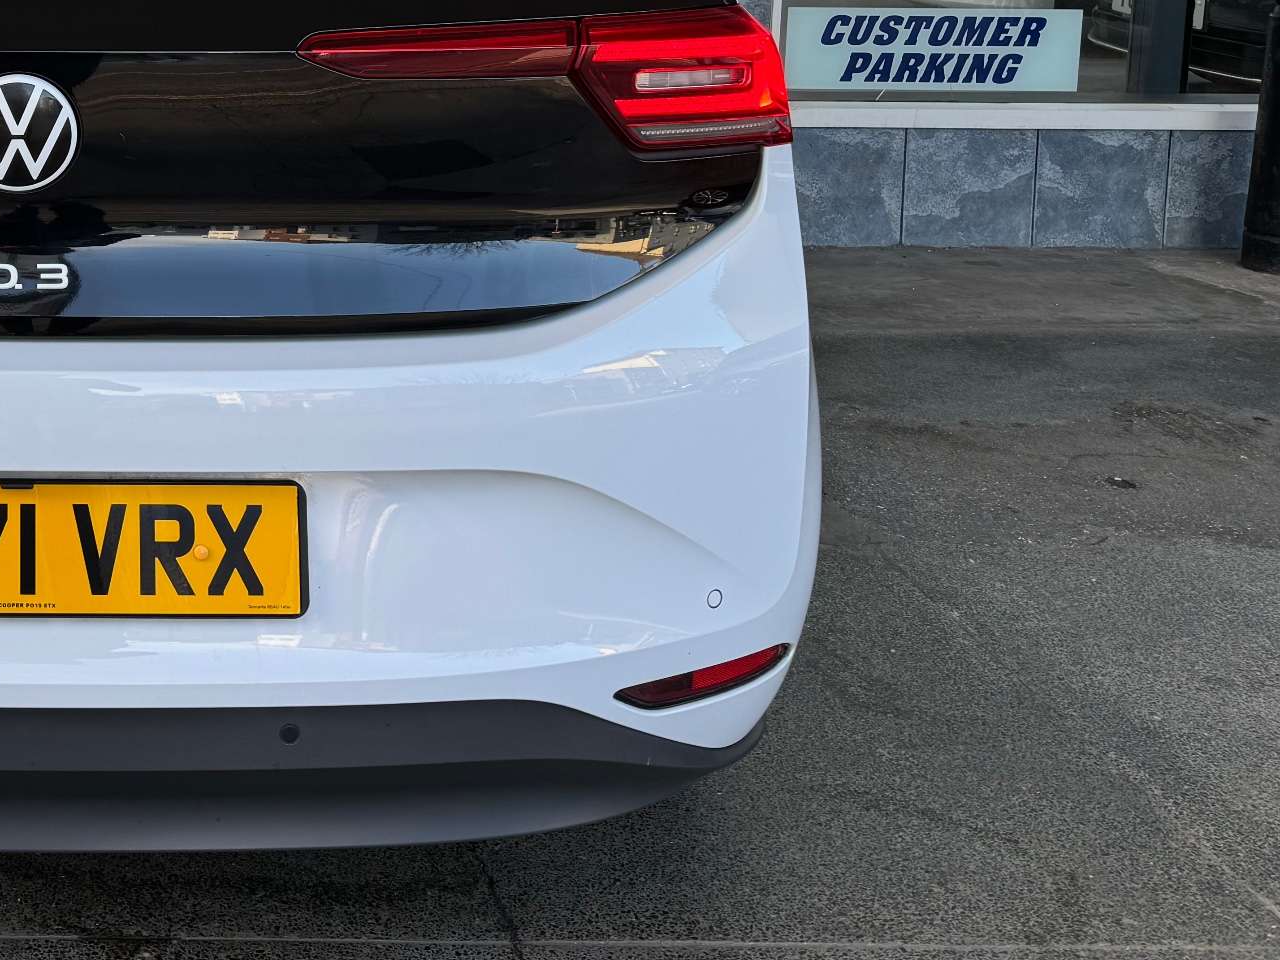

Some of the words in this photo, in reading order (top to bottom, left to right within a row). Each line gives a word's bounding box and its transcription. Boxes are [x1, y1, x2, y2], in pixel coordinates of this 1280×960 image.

[820, 14, 1047, 47] CUSTOMER
[839, 52, 1024, 84] PARKING
[72, 503, 264, 596] VRX
